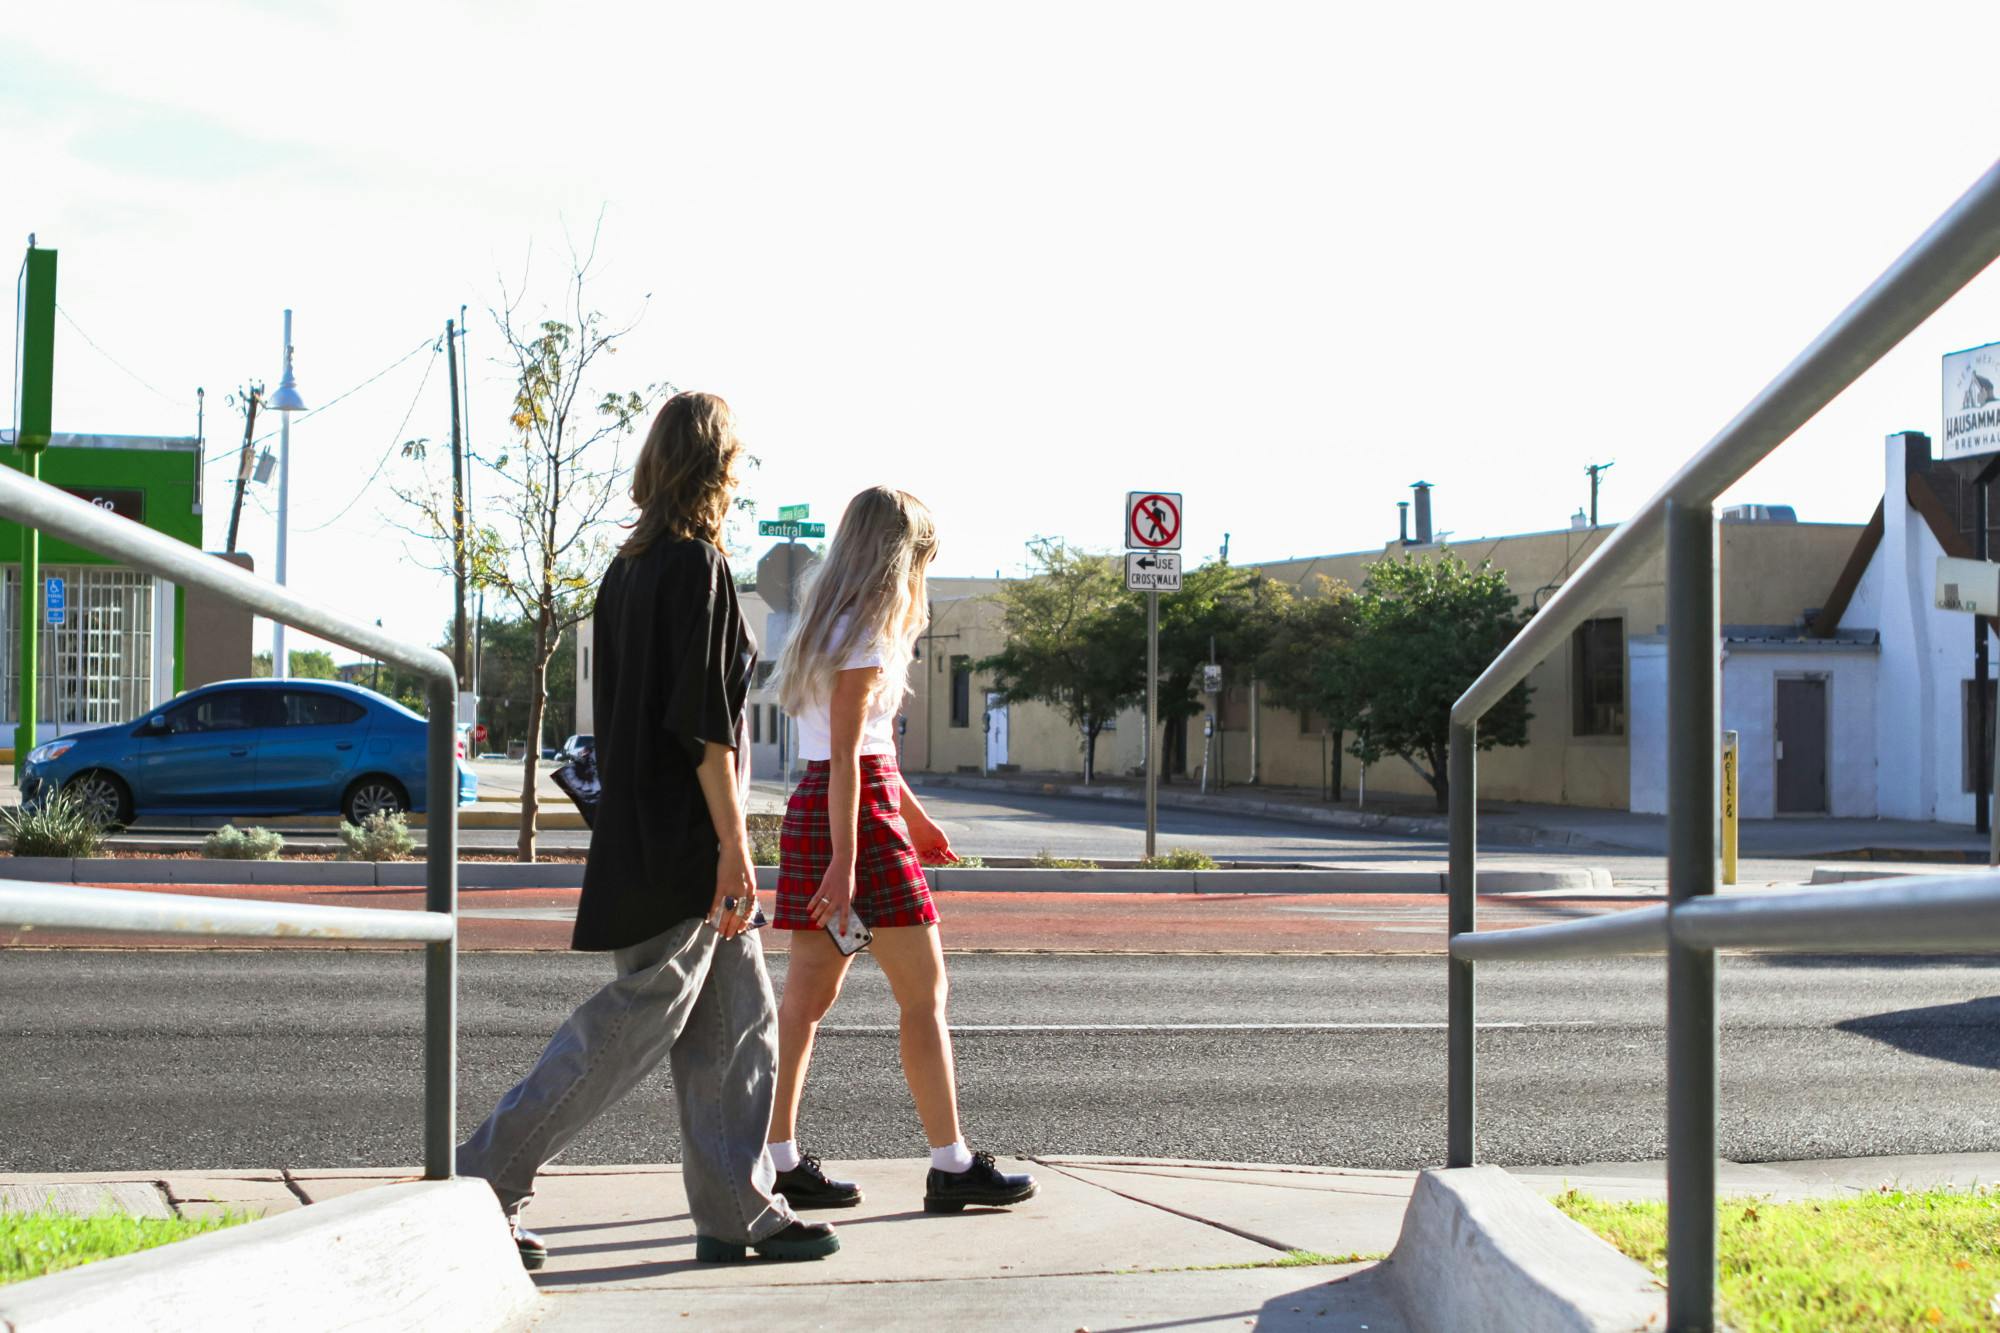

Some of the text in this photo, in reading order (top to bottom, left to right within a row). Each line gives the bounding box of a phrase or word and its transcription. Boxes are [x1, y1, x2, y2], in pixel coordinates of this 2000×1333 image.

[760, 522, 825, 536] Central Ave
[1155, 558, 1174, 569] USE
[1131, 573, 1178, 585] CROSSWALK
